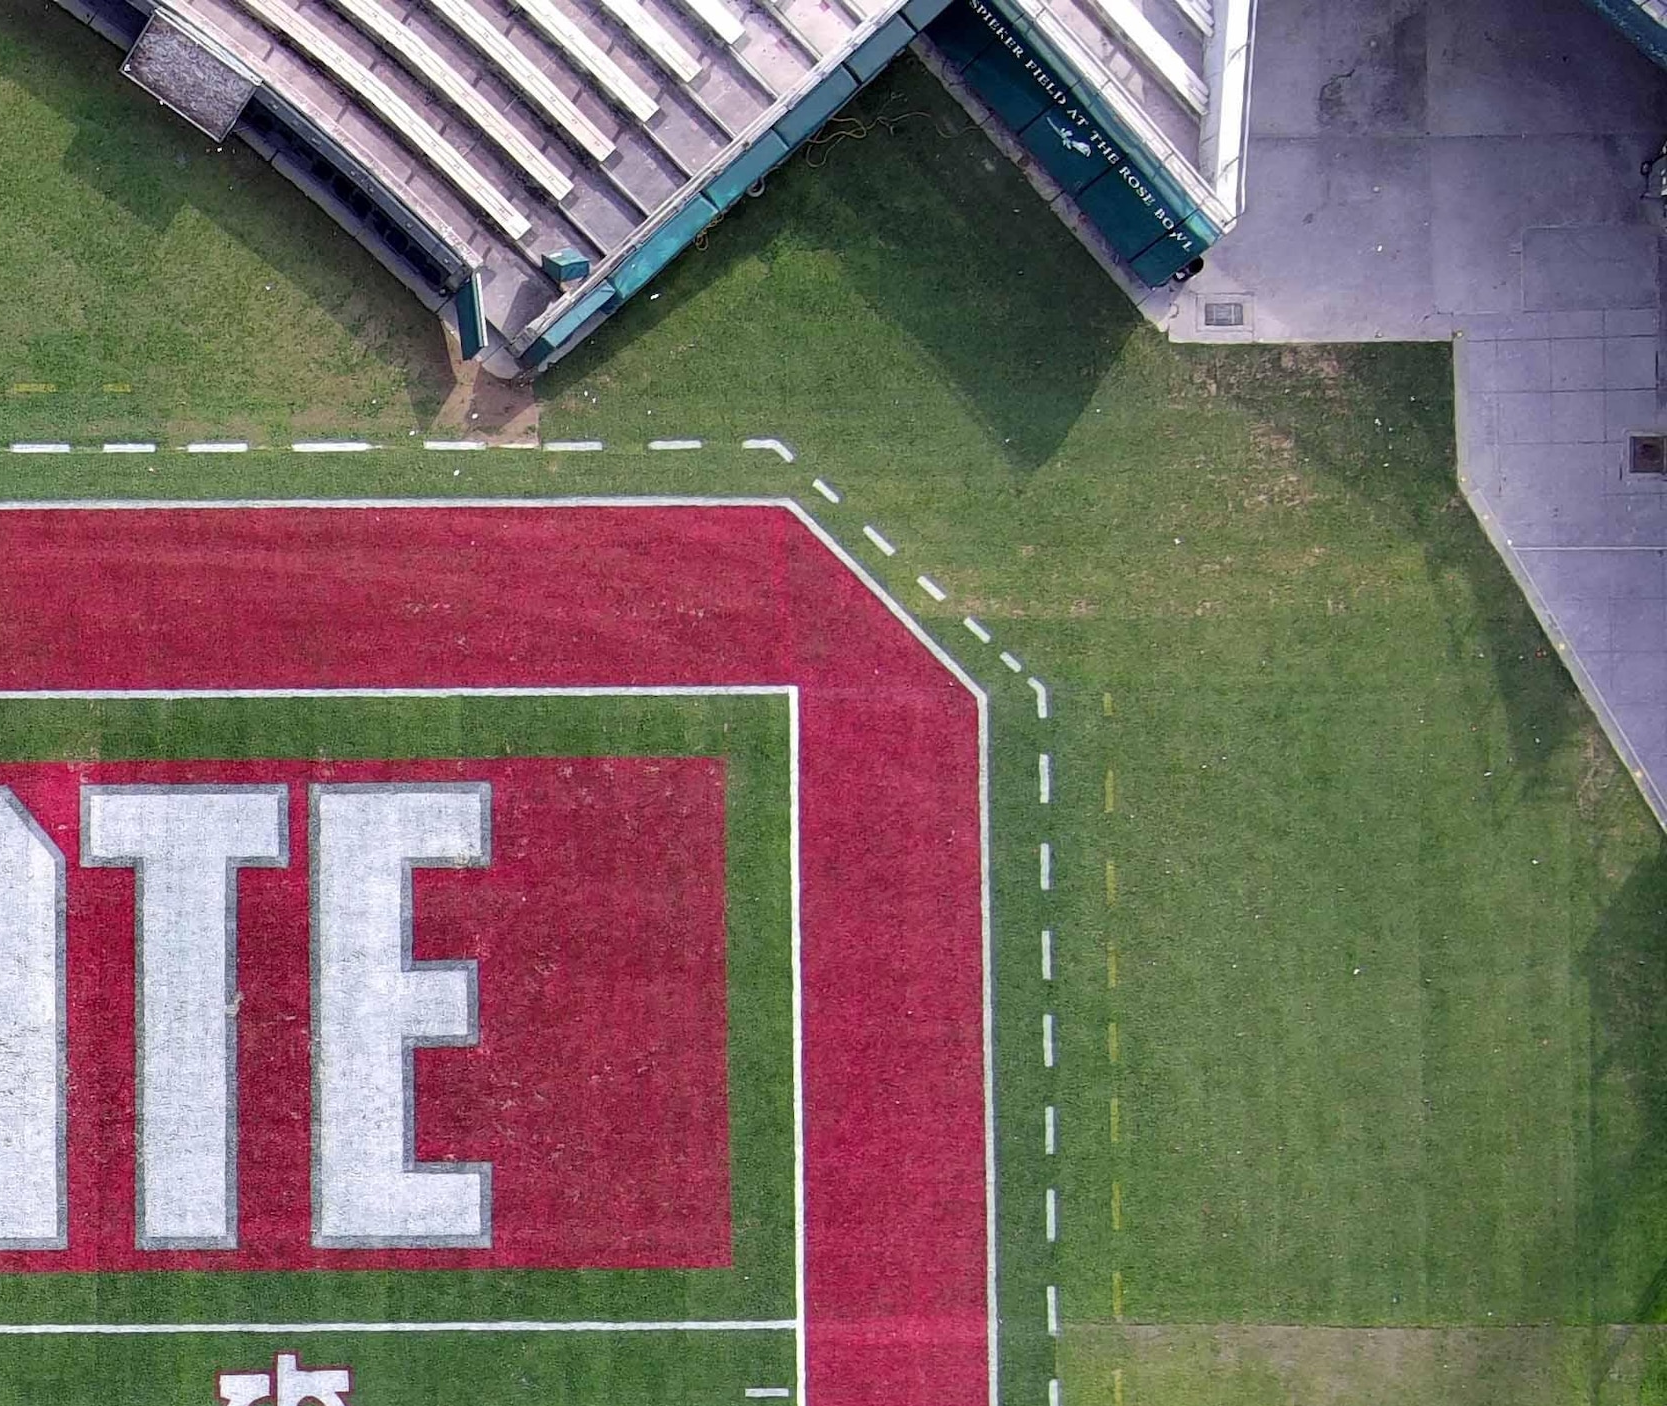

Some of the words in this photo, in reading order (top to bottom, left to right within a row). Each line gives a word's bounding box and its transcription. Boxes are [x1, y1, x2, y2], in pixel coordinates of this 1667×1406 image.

[968, 0, 1024, 59] SPIEKER
[1024, 59, 1067, 106] FIELD
[1066, 107, 1090, 127] AT
[1089, 129, 1120, 165] THE
[1118, 165, 1157, 207] ROSE
[1153, 207, 1194, 253] BOWL
